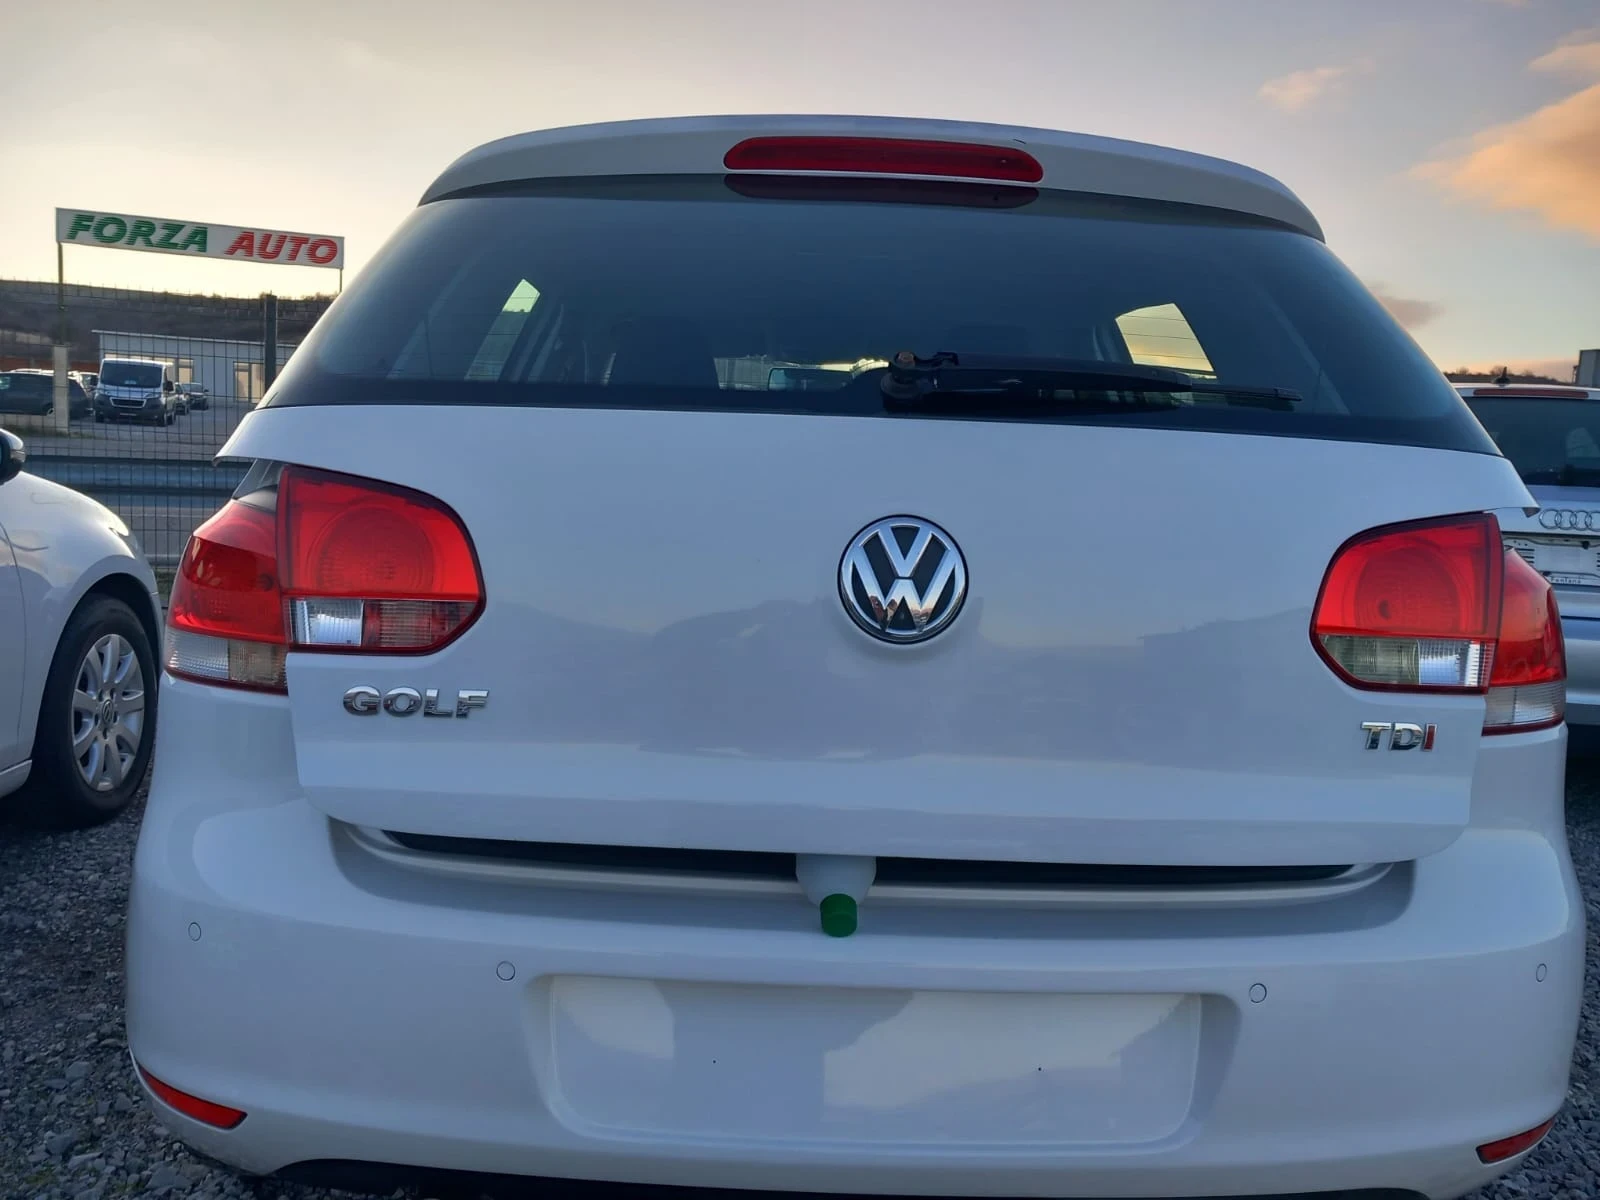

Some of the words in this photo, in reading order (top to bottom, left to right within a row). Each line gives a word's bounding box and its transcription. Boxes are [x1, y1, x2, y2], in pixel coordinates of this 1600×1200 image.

[65, 213, 209, 253] FORZA
[223, 231, 338, 264] AUTO
[343, 685, 489, 719] GOLF
[1361, 721, 1438, 751] TDI
